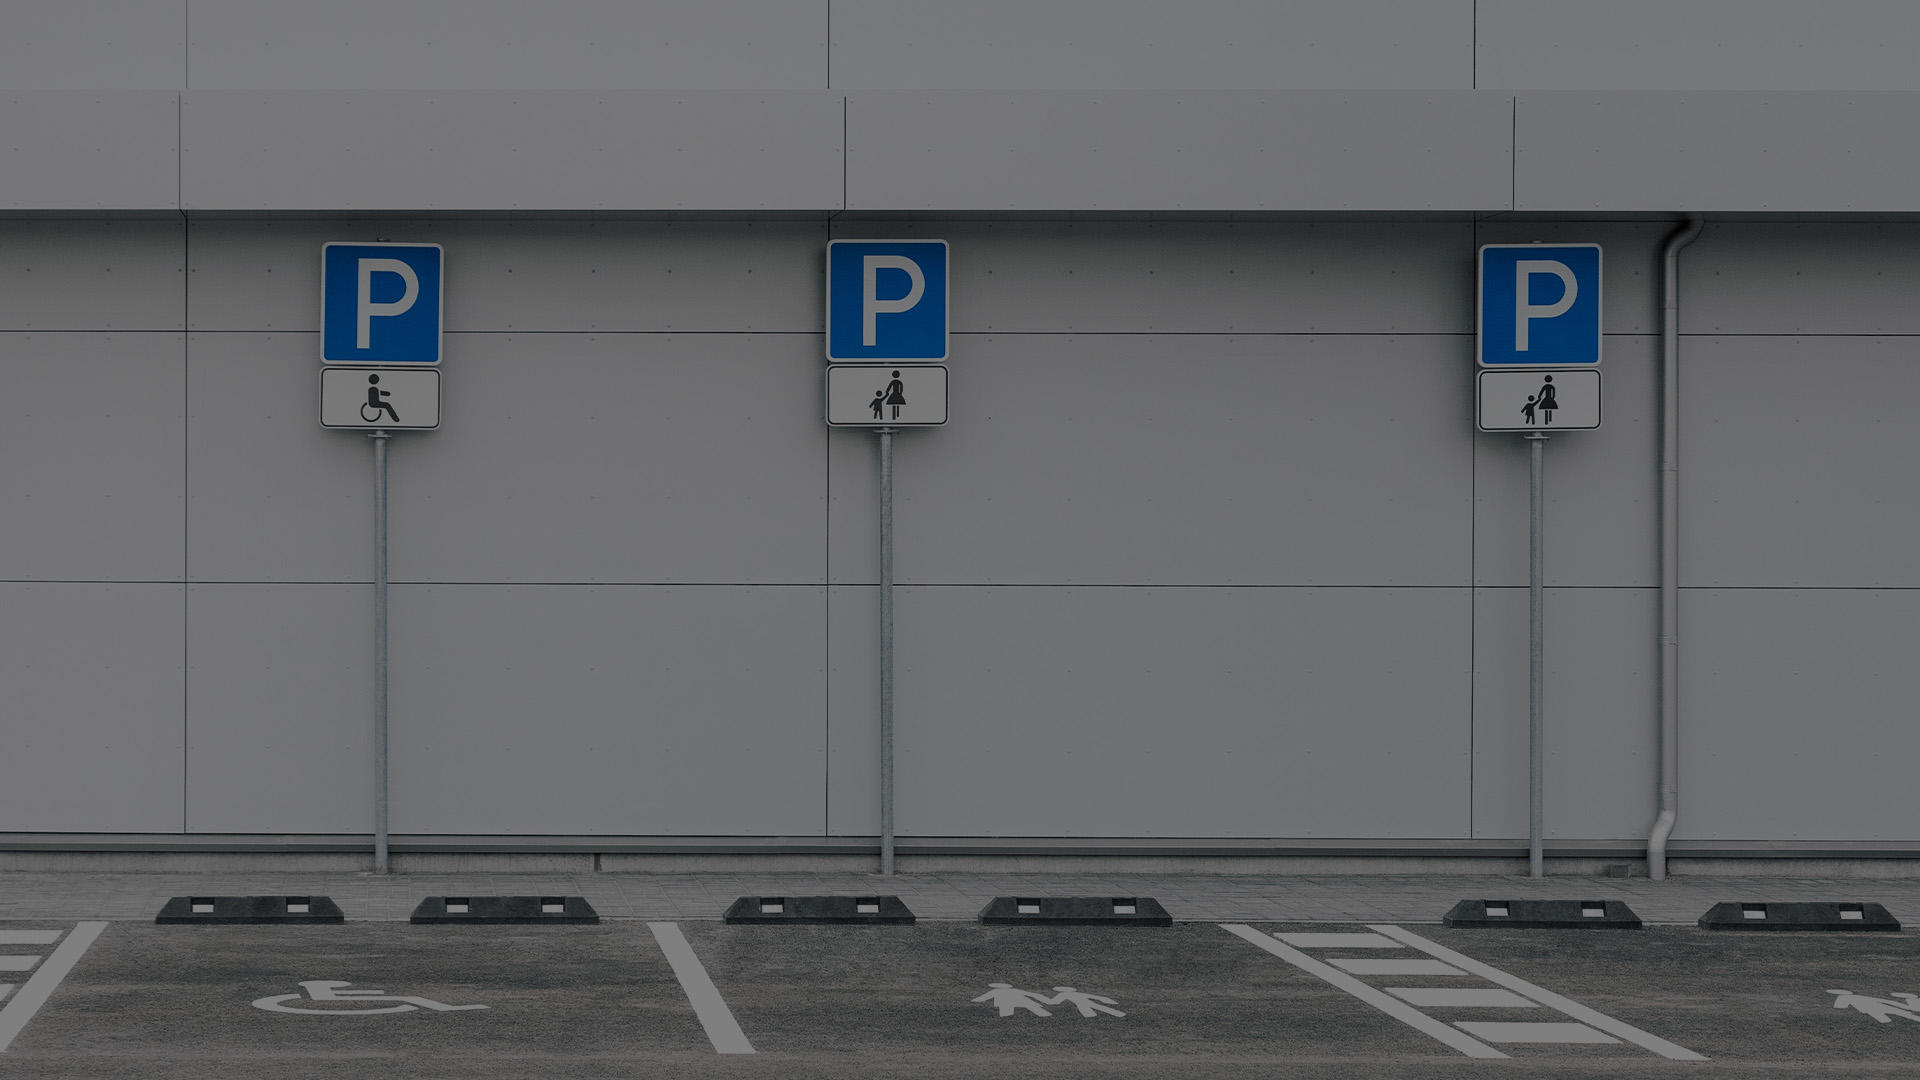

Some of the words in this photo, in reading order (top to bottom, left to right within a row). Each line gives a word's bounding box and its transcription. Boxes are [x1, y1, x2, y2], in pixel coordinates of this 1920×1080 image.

[357, 258, 419, 349] P
[863, 255, 925, 346] P
[1516, 260, 1578, 351] P
